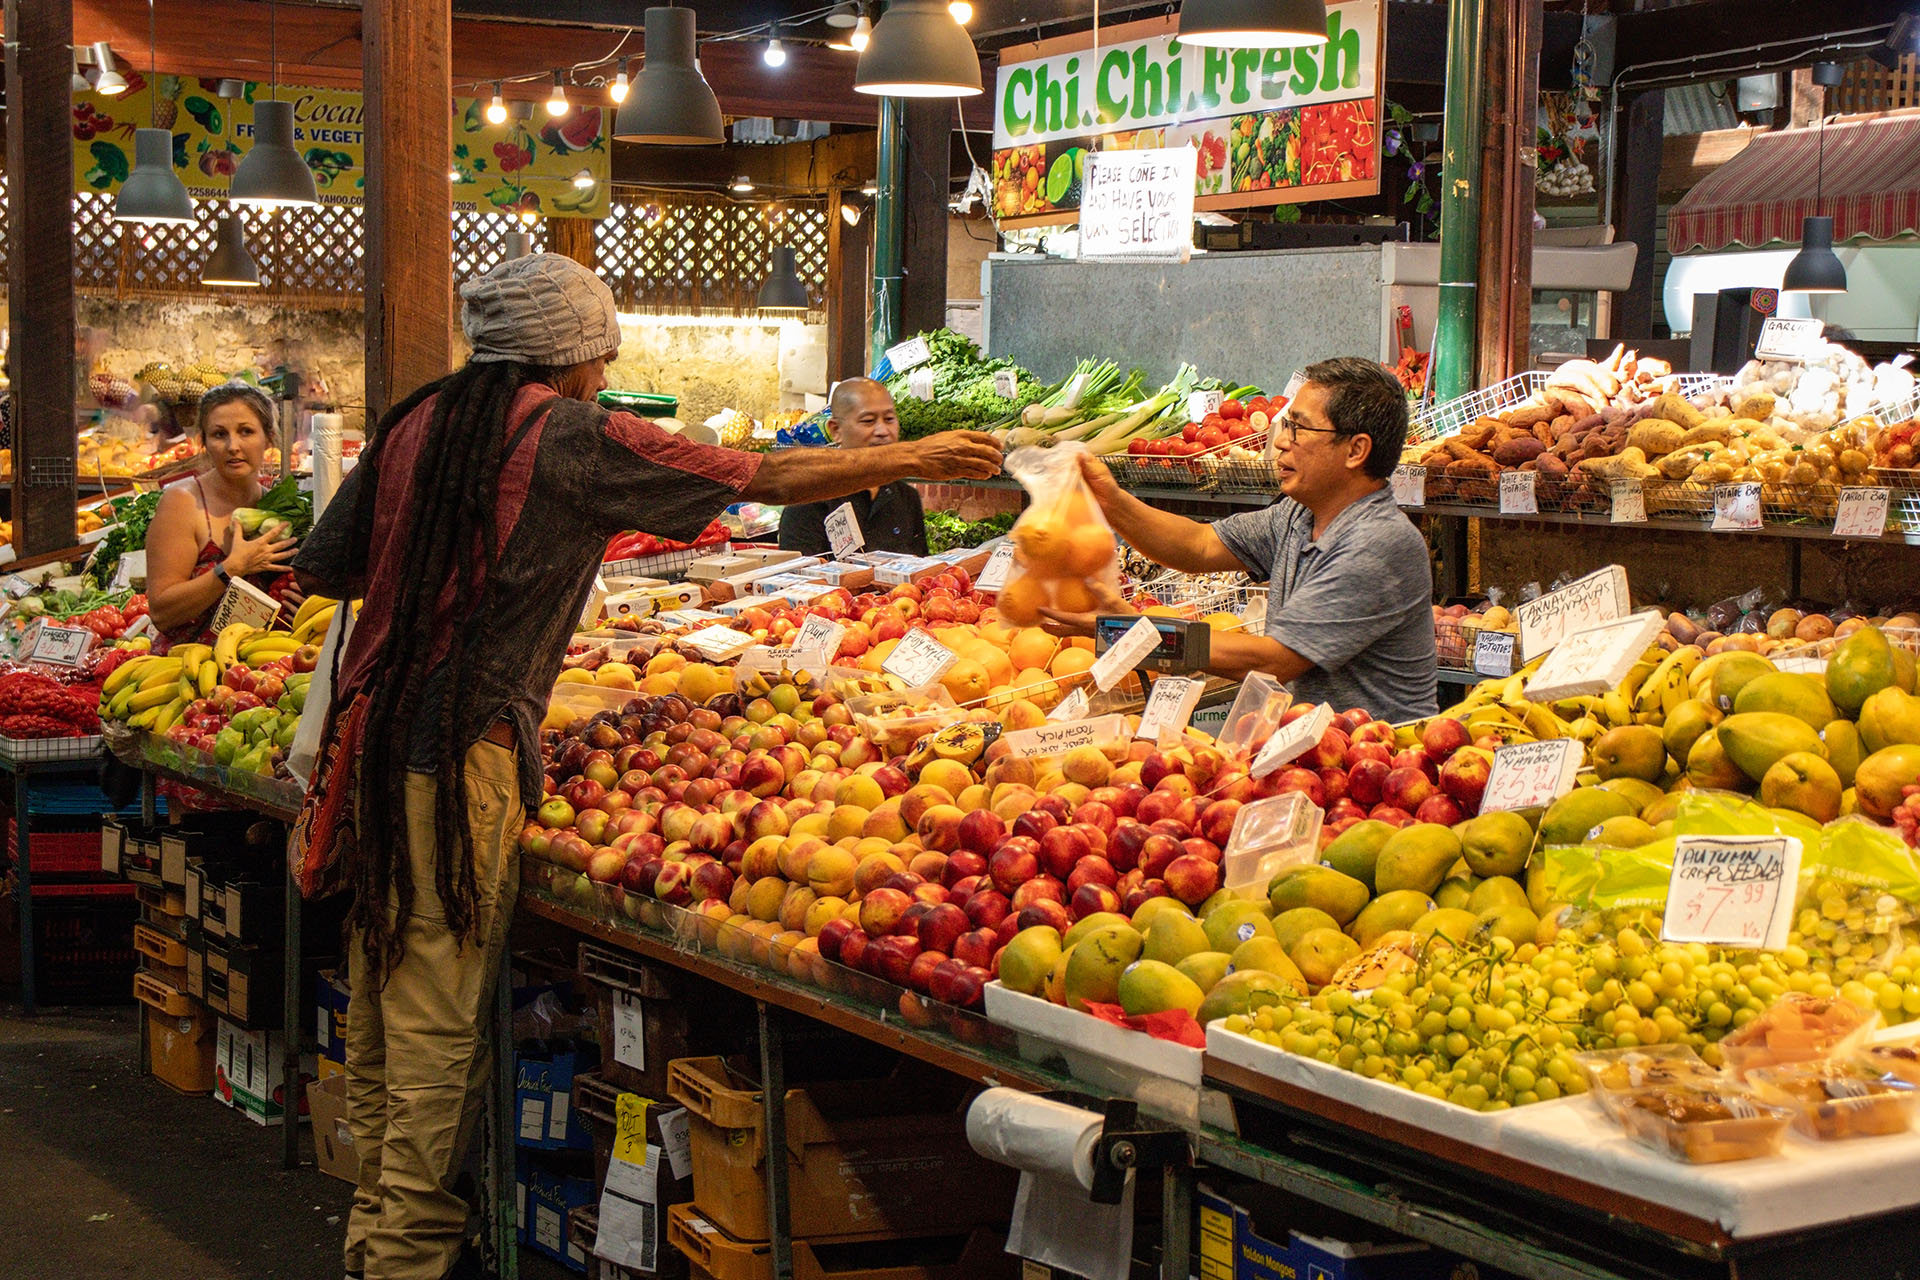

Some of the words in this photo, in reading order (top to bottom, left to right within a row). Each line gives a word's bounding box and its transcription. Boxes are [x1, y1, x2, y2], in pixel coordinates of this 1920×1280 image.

[310, 128, 364, 144] VEGET
[1090, 164, 1122, 190] PLEASE
[1129, 166, 1156, 183] COME
[318, 194, 364, 206] YAHOO.CO
[1112, 189, 1142, 210] HAVE
[1192, 709, 1231, 721] urme
[1681, 848, 1761, 866] AUTUMN
